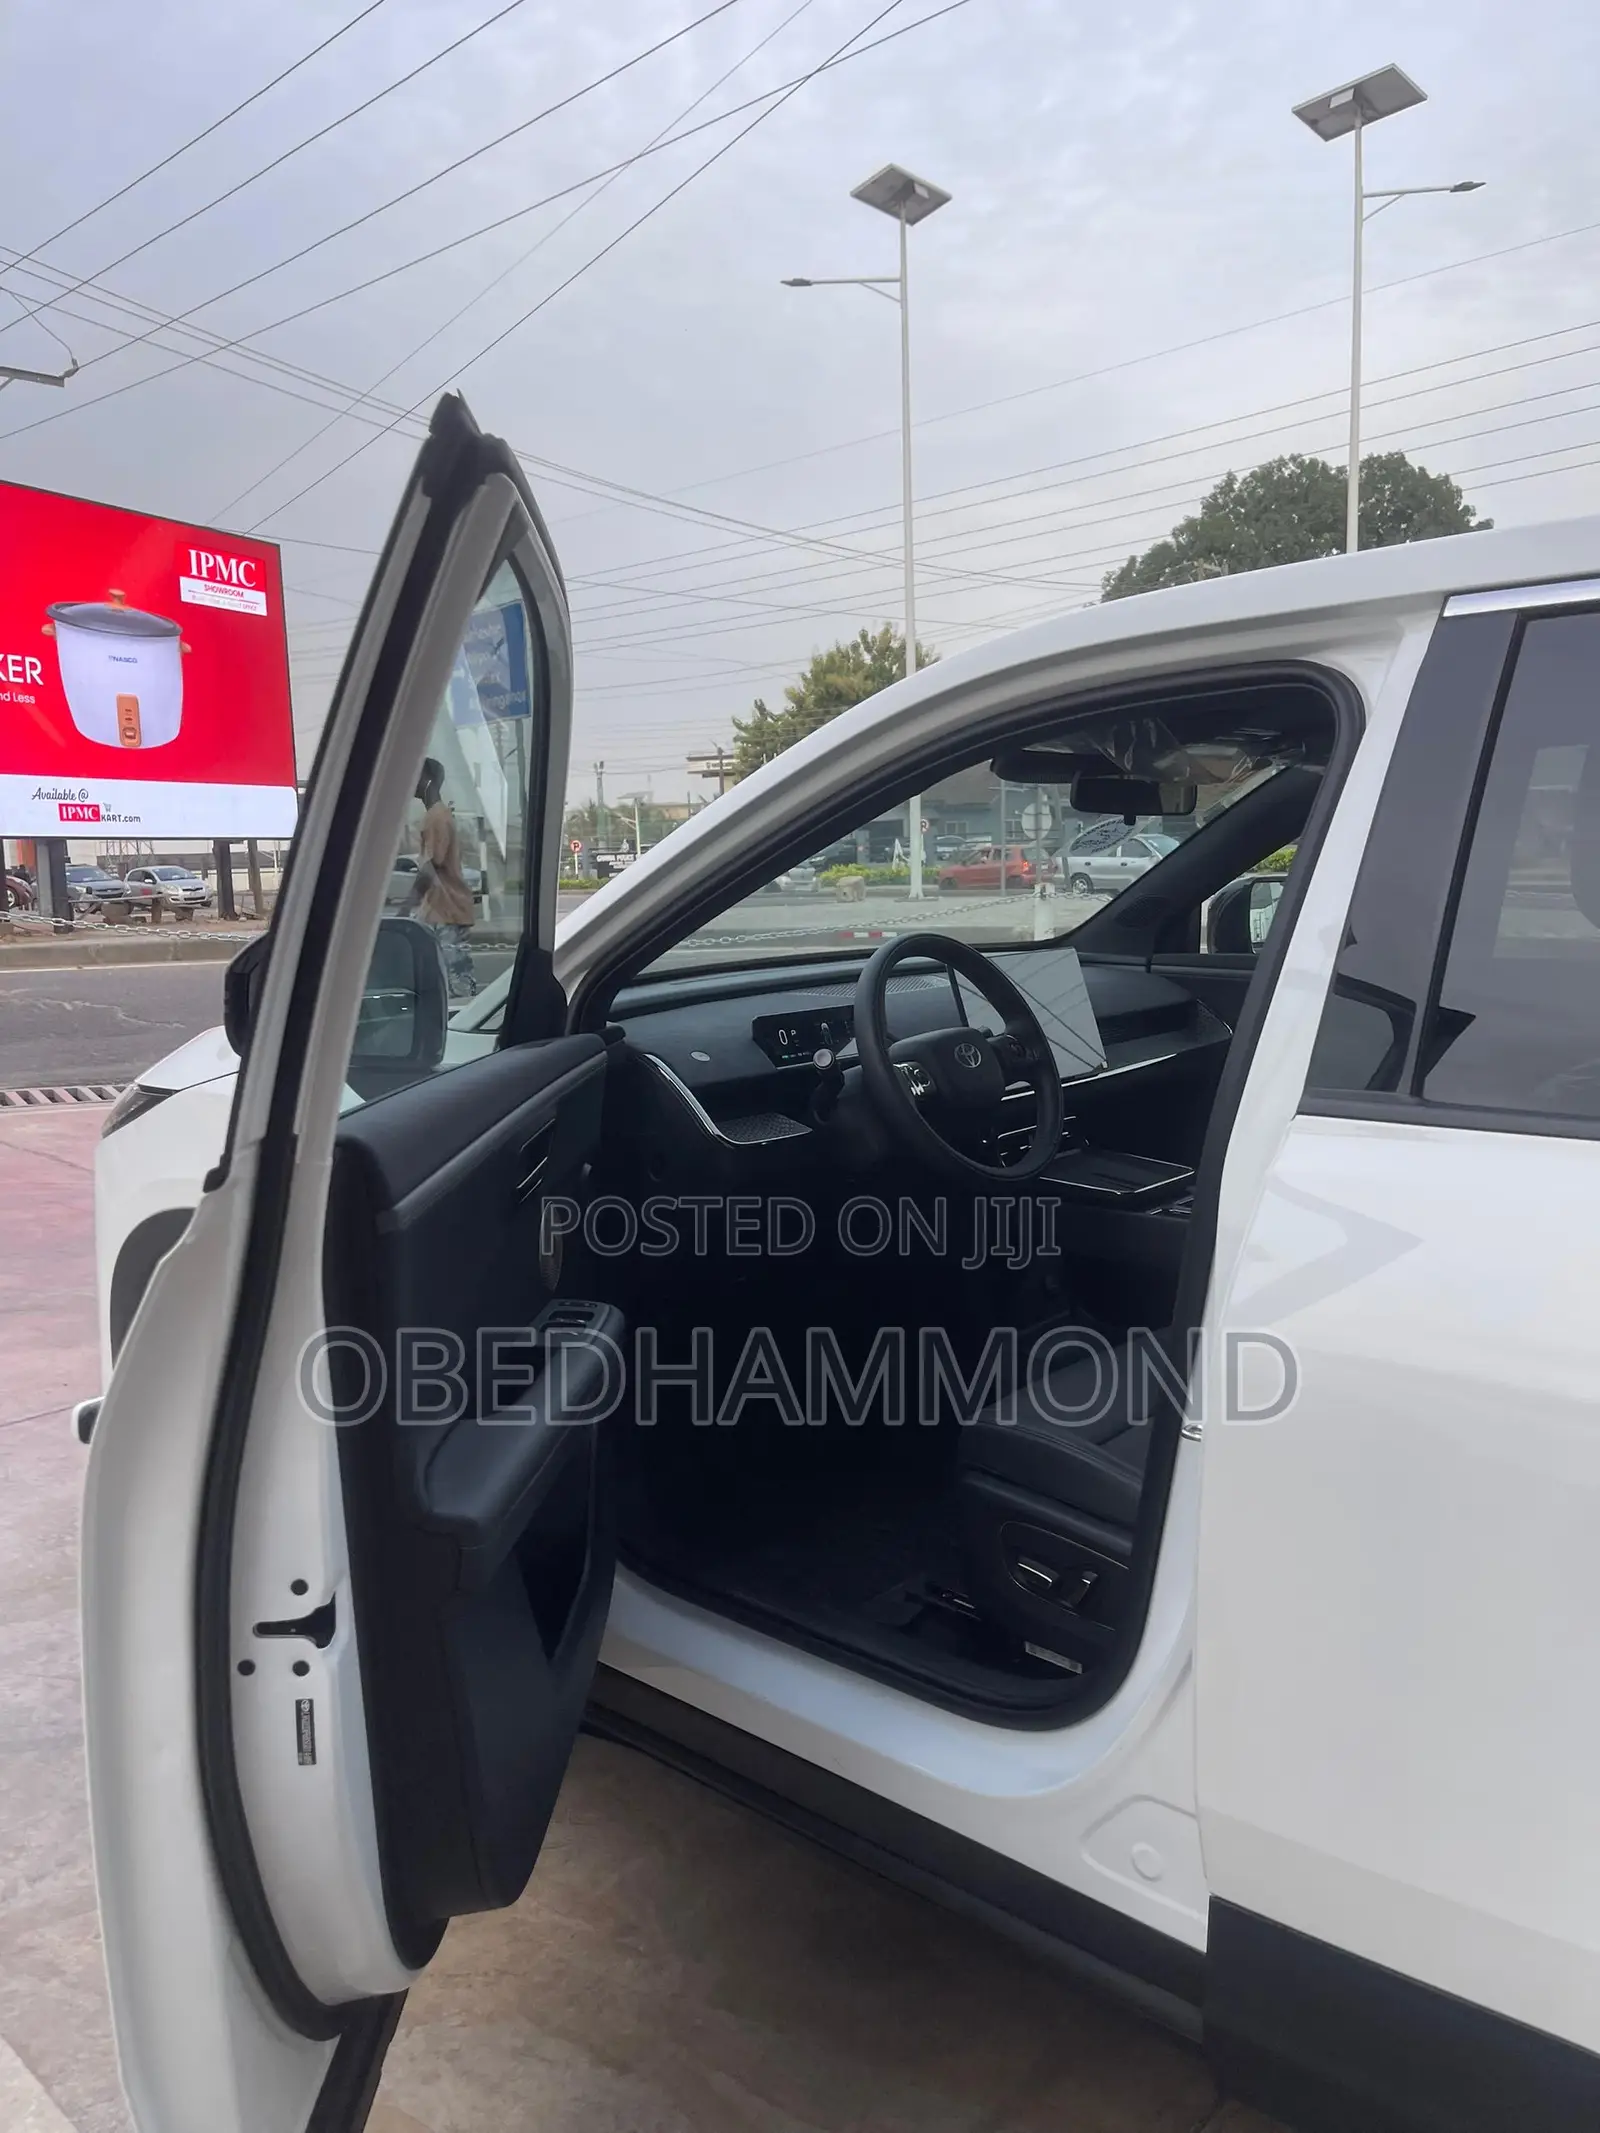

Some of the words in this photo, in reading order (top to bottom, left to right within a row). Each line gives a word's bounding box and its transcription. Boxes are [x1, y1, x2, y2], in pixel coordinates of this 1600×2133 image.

[188, 549, 257, 588] IPMC
[203, 583, 245, 599] SHOWROOM
[13, 692, 36, 704] Less
[31, 787, 77, 801] Available
[77, 788, 89, 803] @
[61, 805, 99, 820] IPMC
[101, 814, 141, 823] KART.com
